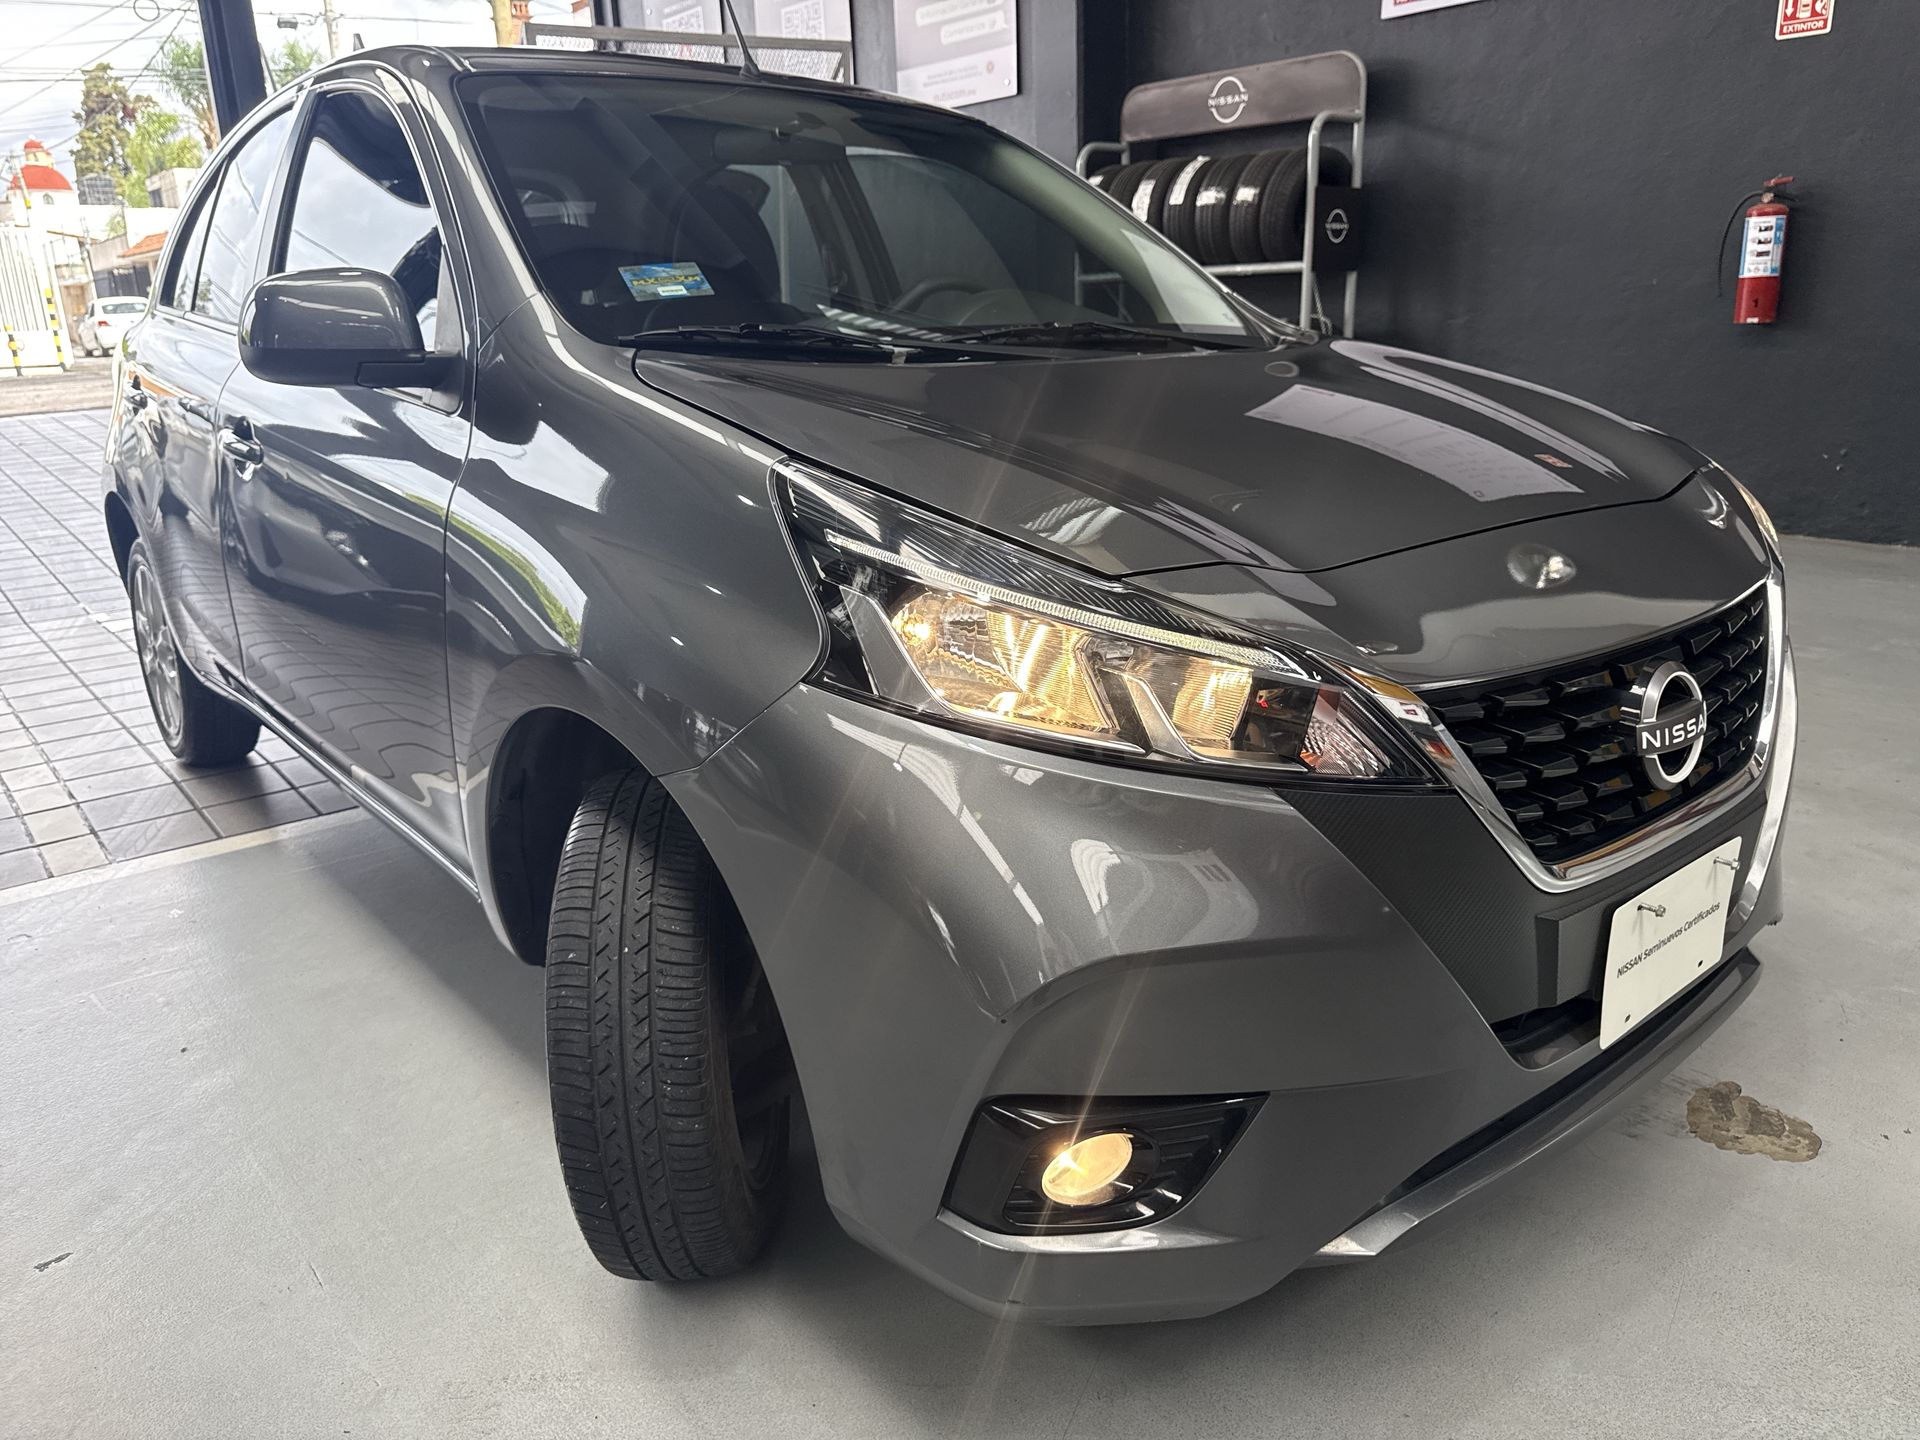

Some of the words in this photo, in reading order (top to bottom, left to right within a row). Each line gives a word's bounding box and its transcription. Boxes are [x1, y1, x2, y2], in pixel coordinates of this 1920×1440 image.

[1782, 20, 1825, 33] EXTINTOR
[1208, 93, 1248, 107] NISSAN
[1641, 708, 1706, 749] NISSA
[1617, 953, 1643, 978] NISSAN
[1643, 927, 1683, 960] Seminuevos
[1683, 902, 1721, 932] Certificados
